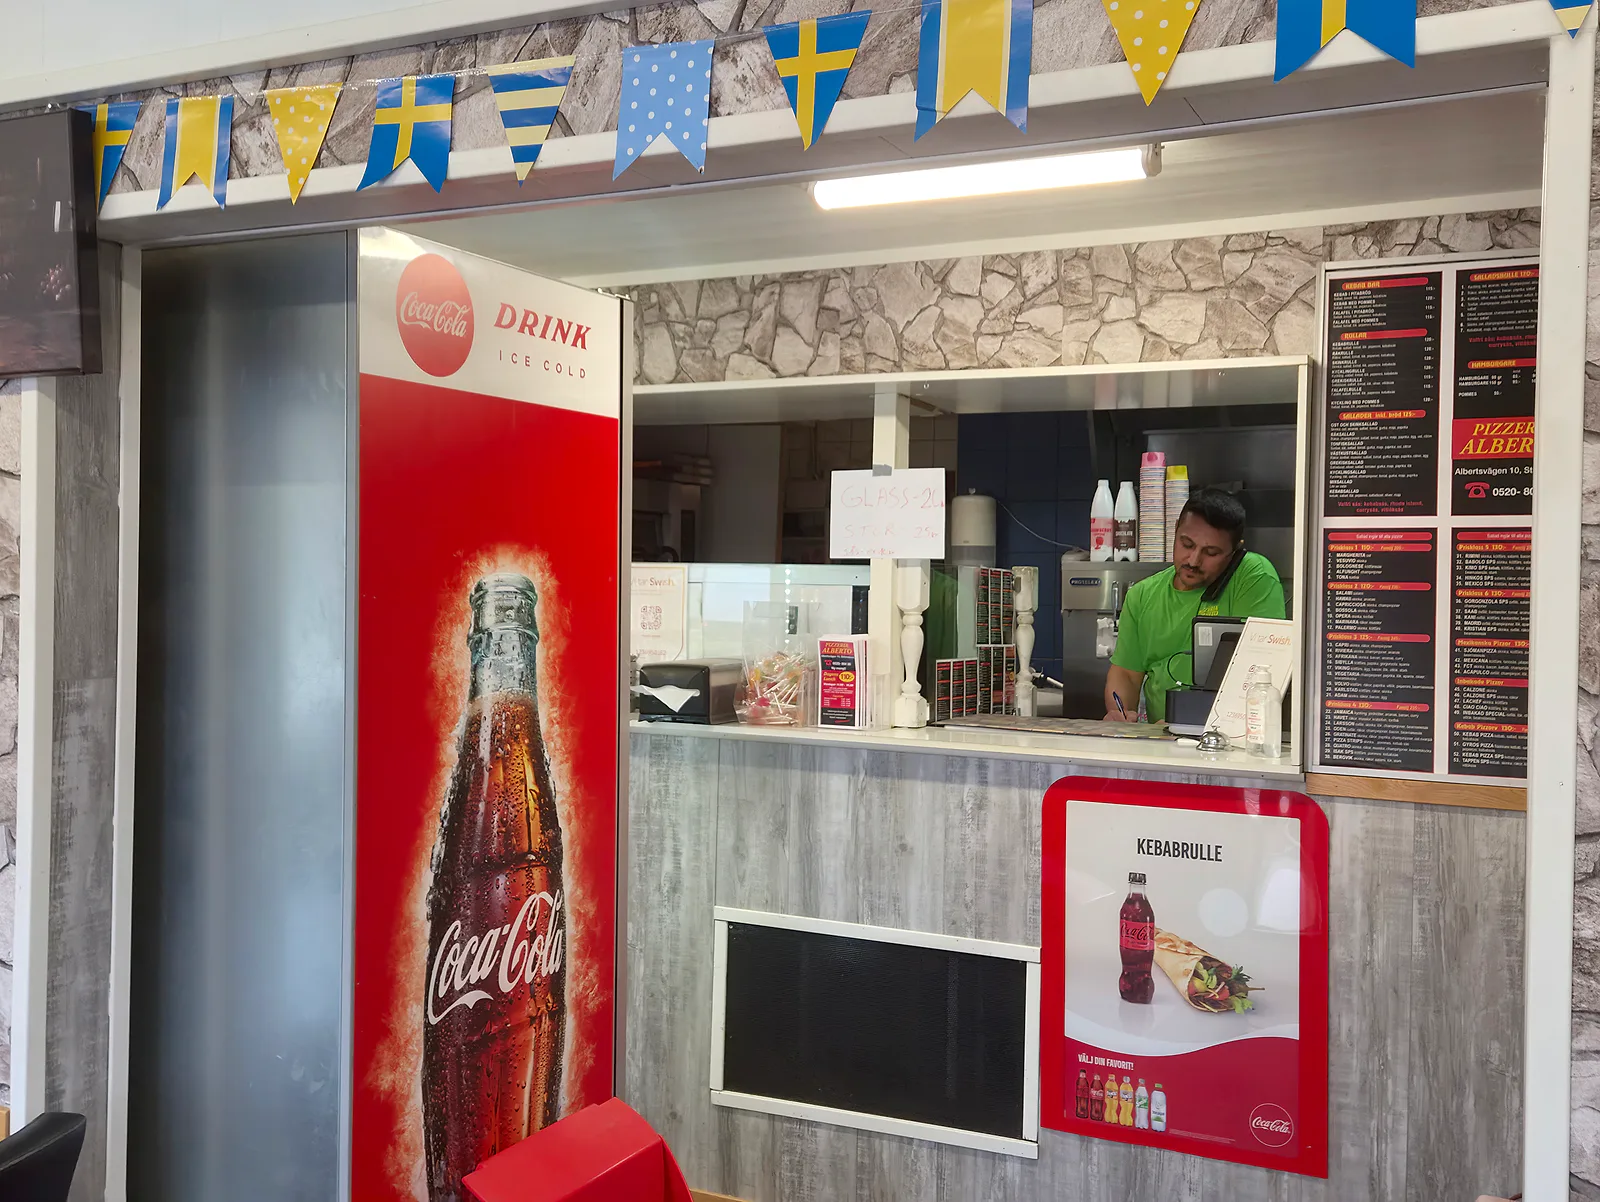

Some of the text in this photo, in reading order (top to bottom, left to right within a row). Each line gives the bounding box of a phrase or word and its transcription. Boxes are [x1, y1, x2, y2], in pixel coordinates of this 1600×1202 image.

[400, 291, 470, 337] Coca-Cola
[494, 302, 592, 350] DRINK
[500, 350, 586, 379] ICE COLD
[1455, 468, 1507, 476] Albertsvägen
[1492, 487, 1520, 497] 0520-
[1137, 838, 1223, 862] KEBABRULLE
[428, 890, 563, 1025] Coca-Cola
[1078, 1052, 1134, 1071] VÄLJ DIN FAVORIT!
[1252, 1116, 1291, 1134] Coca-Cola
